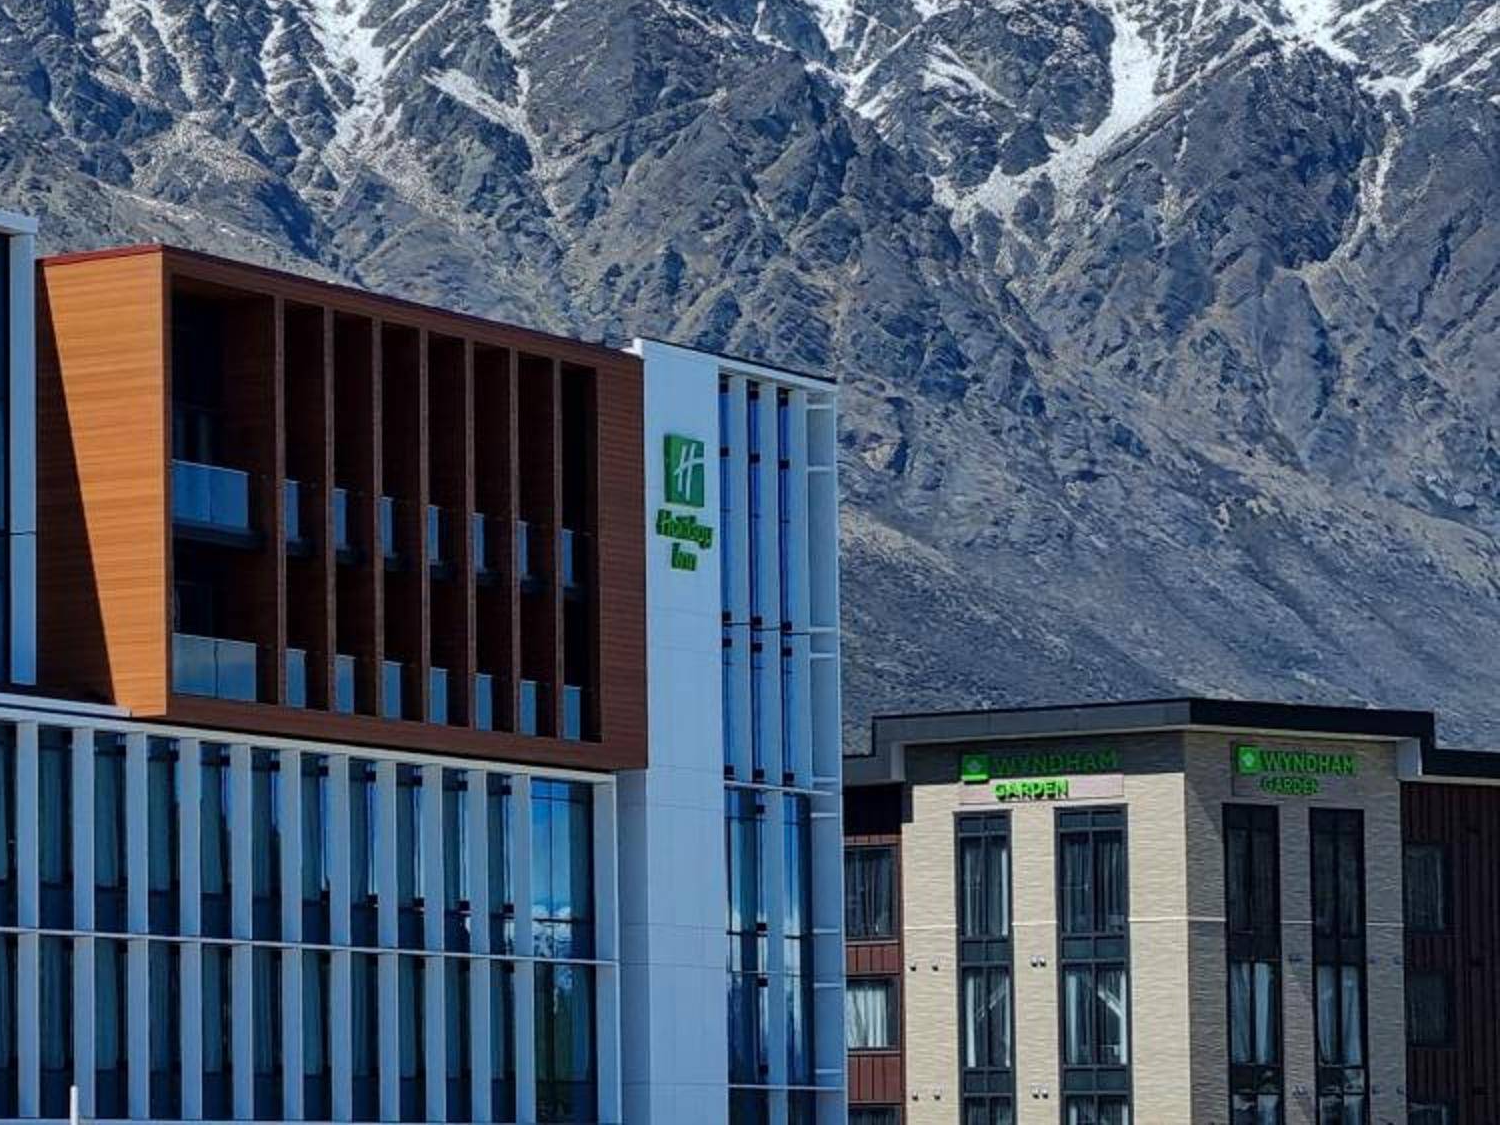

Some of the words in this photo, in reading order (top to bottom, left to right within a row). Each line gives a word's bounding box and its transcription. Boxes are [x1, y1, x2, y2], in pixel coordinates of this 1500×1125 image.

[656, 509, 713, 550] Holiday
[994, 747, 1119, 774] WYNDHAM
[1260, 750, 1356, 775] WYNDHAM
[994, 779, 1069, 799] GARDEN
